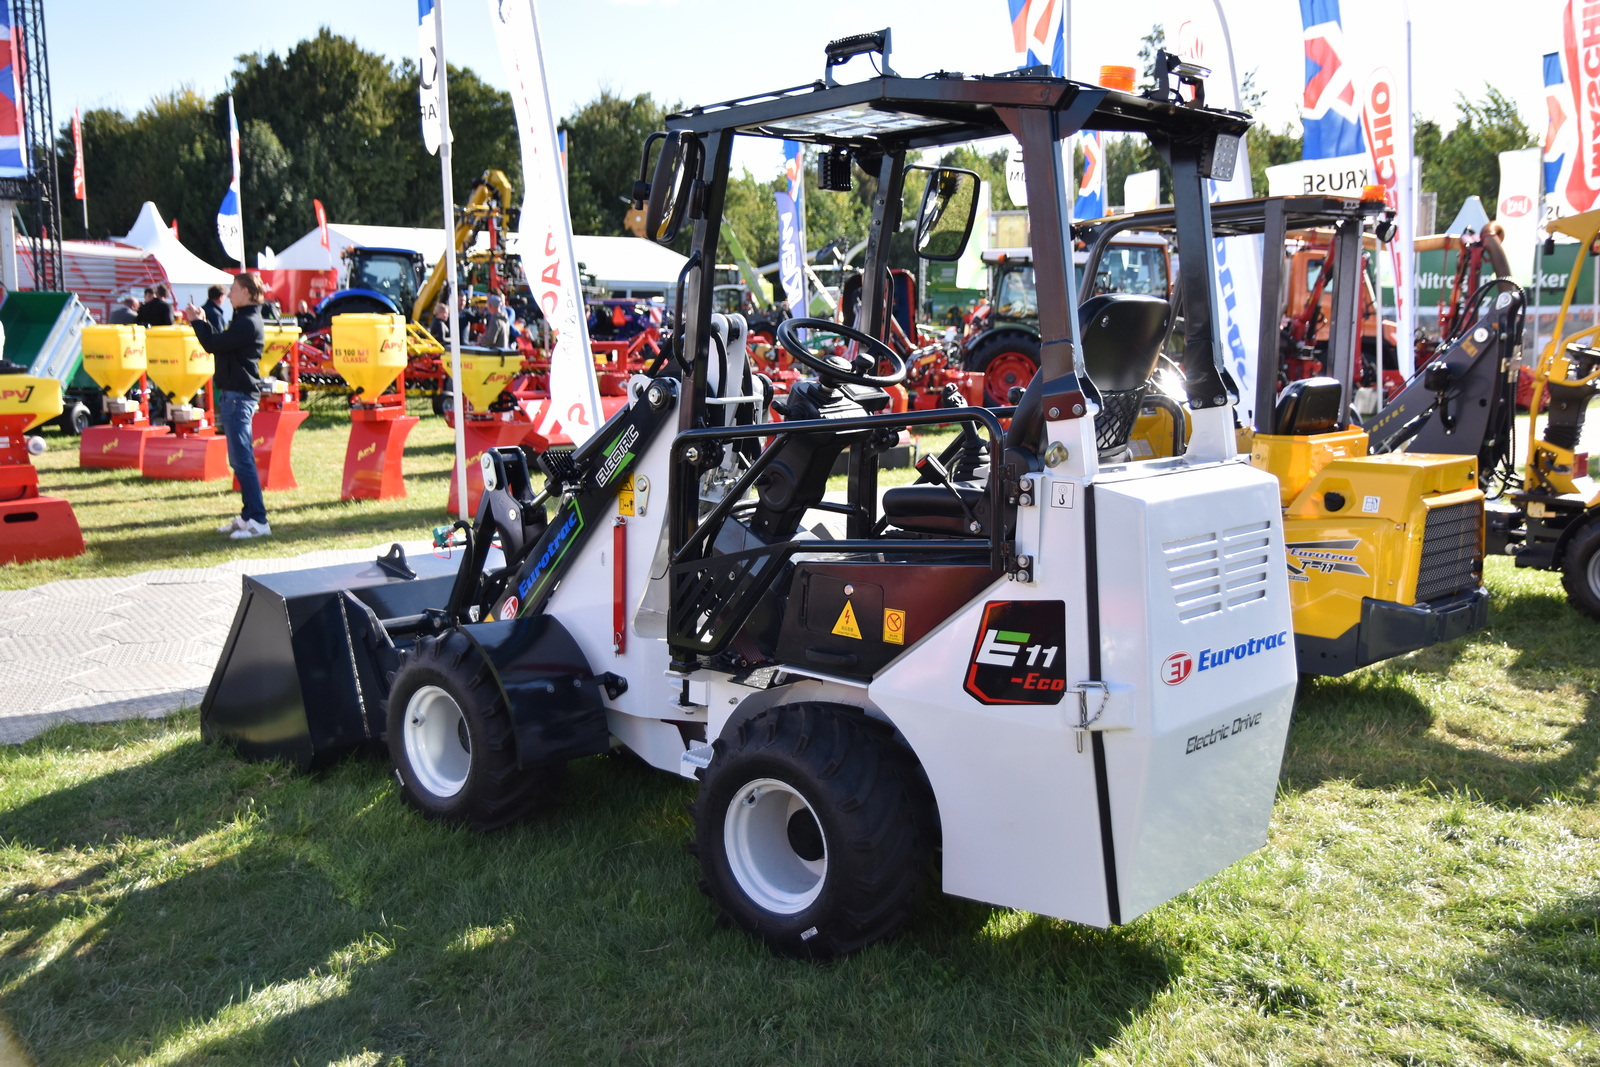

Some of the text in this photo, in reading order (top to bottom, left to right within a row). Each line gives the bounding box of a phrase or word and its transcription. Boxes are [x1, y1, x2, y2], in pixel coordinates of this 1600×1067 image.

[0, 388, 31, 401] PV
[518, 511, 578, 600] Eurotrac
[1290, 548, 1358, 562] Eurotrac
[1198, 631, 1287, 672] Eurotrac
[1186, 712, 1262, 755] Electric Drive
